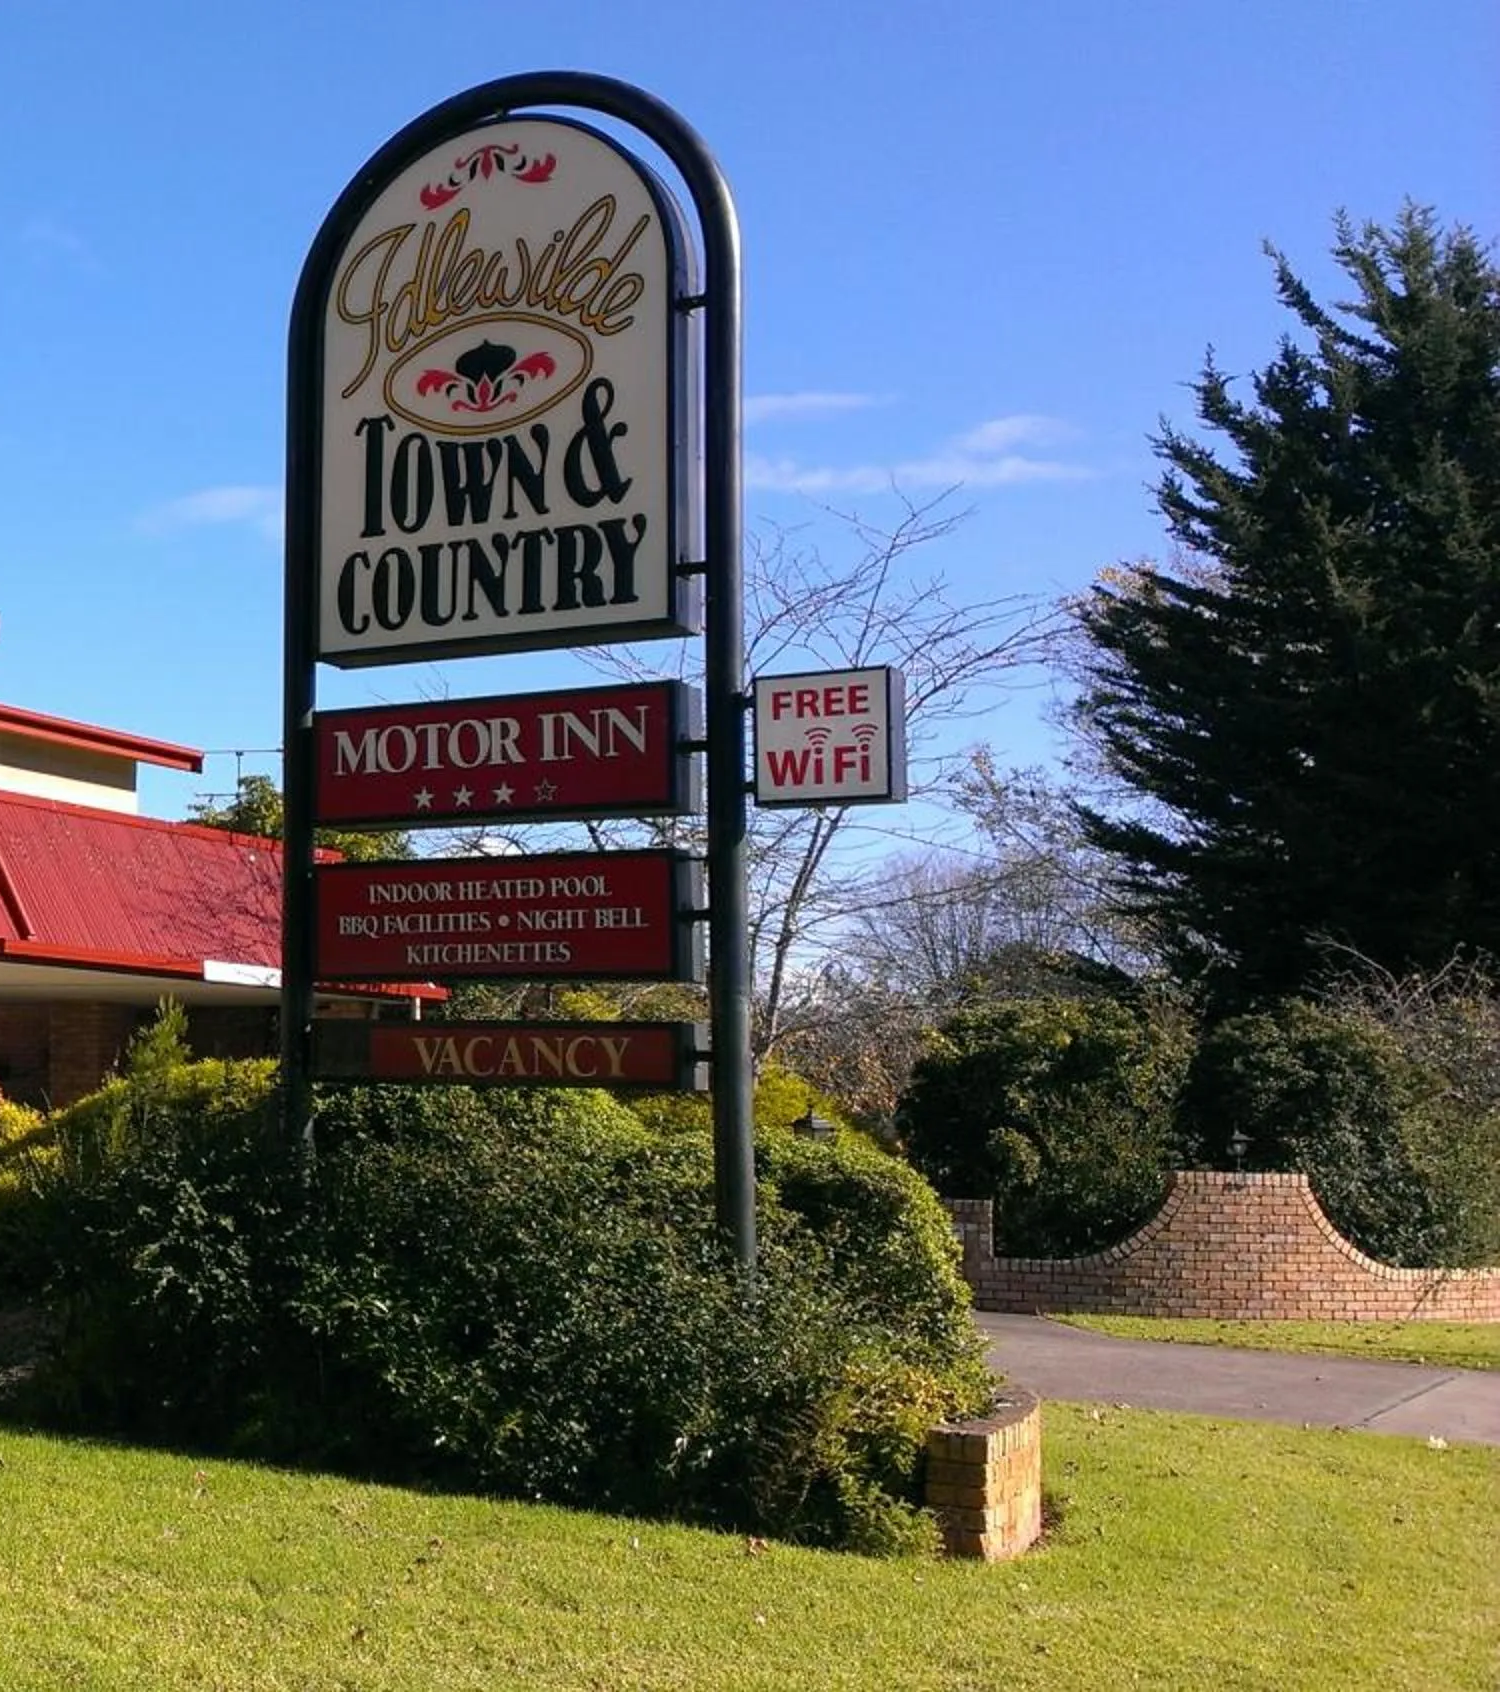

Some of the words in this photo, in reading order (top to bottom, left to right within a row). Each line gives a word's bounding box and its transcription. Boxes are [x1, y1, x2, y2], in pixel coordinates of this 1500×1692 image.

[337, 194, 651, 398] Idlewilde
[354, 414, 549, 538] TOWN
[563, 377, 633, 508] &
[337, 513, 647, 636] COUNTRY
[772, 684, 870, 720] FREE
[333, 717, 525, 777] MOTOR
[540, 705, 649, 761] INN
[368, 881, 453, 905] INDOOR
[459, 878, 545, 900] HEATED
[550, 875, 612, 898] POOL
[339, 915, 380, 938] BBQ
[383, 911, 491, 934] FACILITIES
[517, 909, 589, 931] NIGHT
[595, 907, 649, 928] BELL
[406, 942, 571, 965] KITCHENETTES
[414, 1037, 632, 1076] VACANCY
